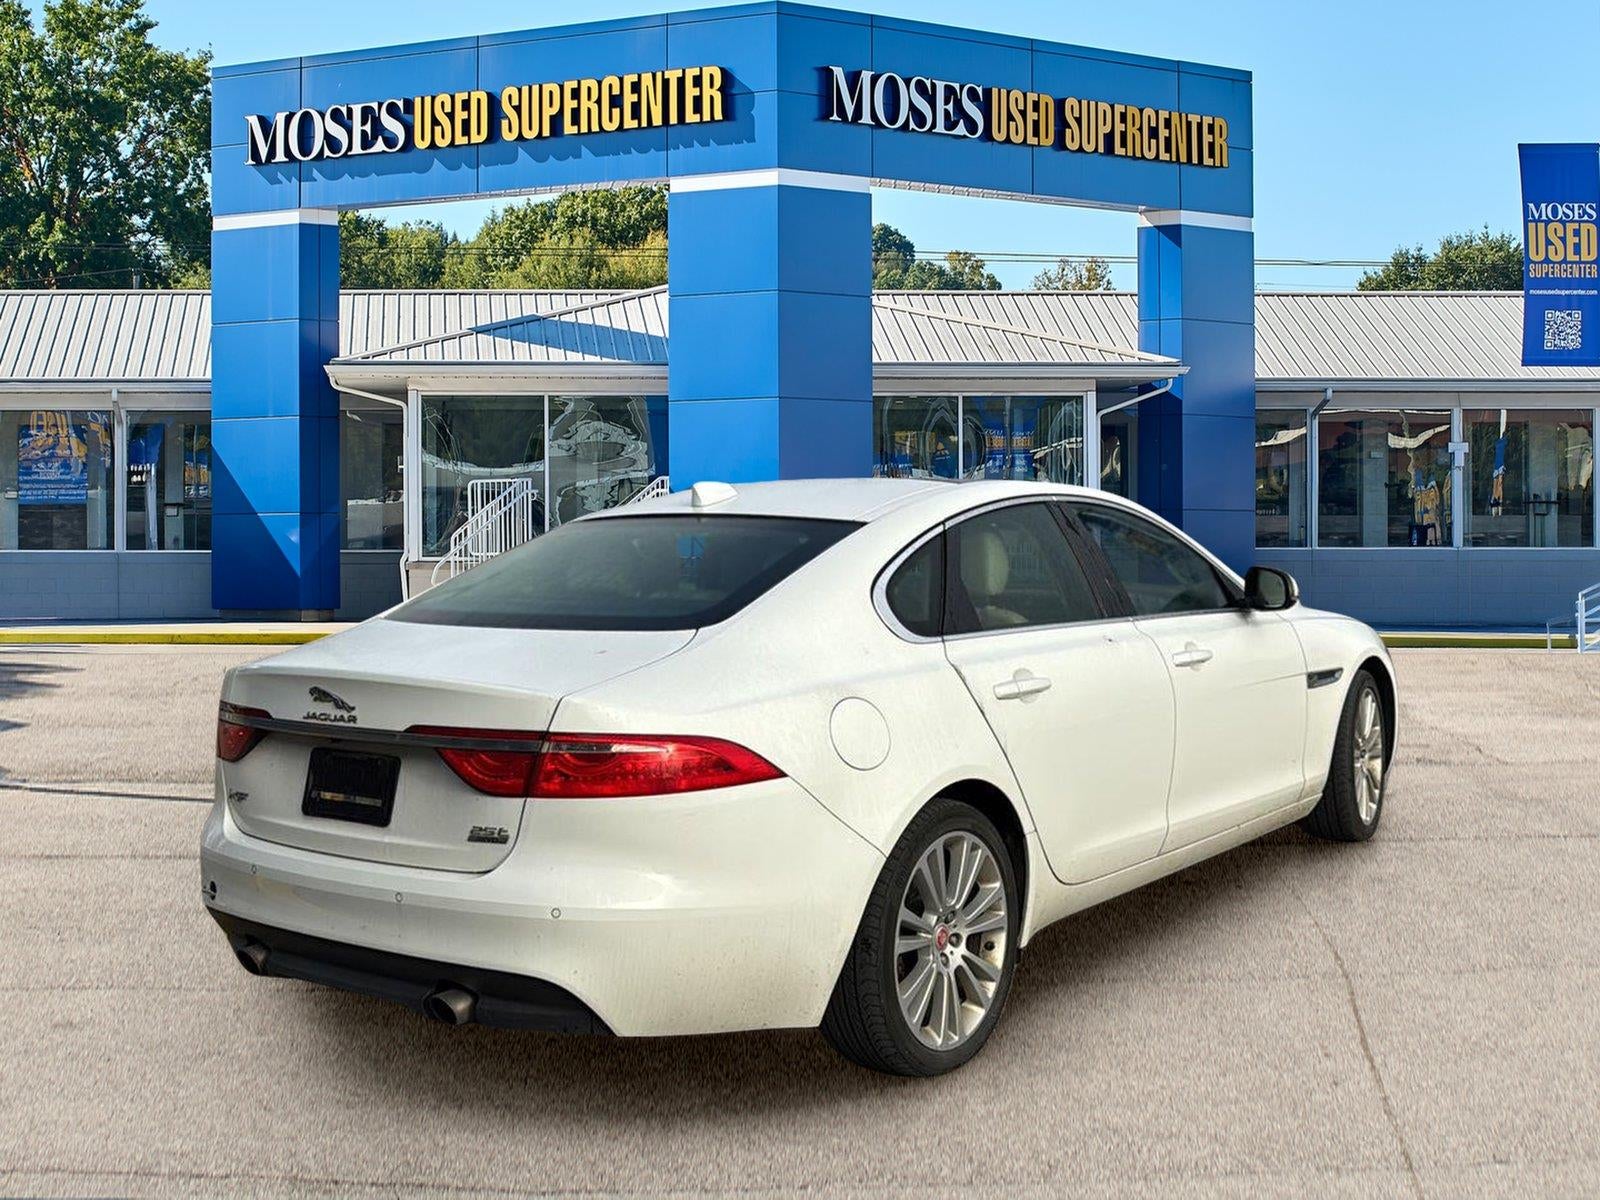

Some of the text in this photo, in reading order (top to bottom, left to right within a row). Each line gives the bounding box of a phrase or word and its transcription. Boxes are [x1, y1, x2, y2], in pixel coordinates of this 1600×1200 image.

[244, 65, 723, 166] MOSES USED SUPERCENTER
[828, 66, 1229, 168] MOSES USED SUPERCENTER
[1527, 202, 1597, 221] MOSES
[1528, 222, 1598, 262] USED
[1529, 263, 1598, 278] SUPERCENTER
[302, 711, 358, 724] JAGUAR
